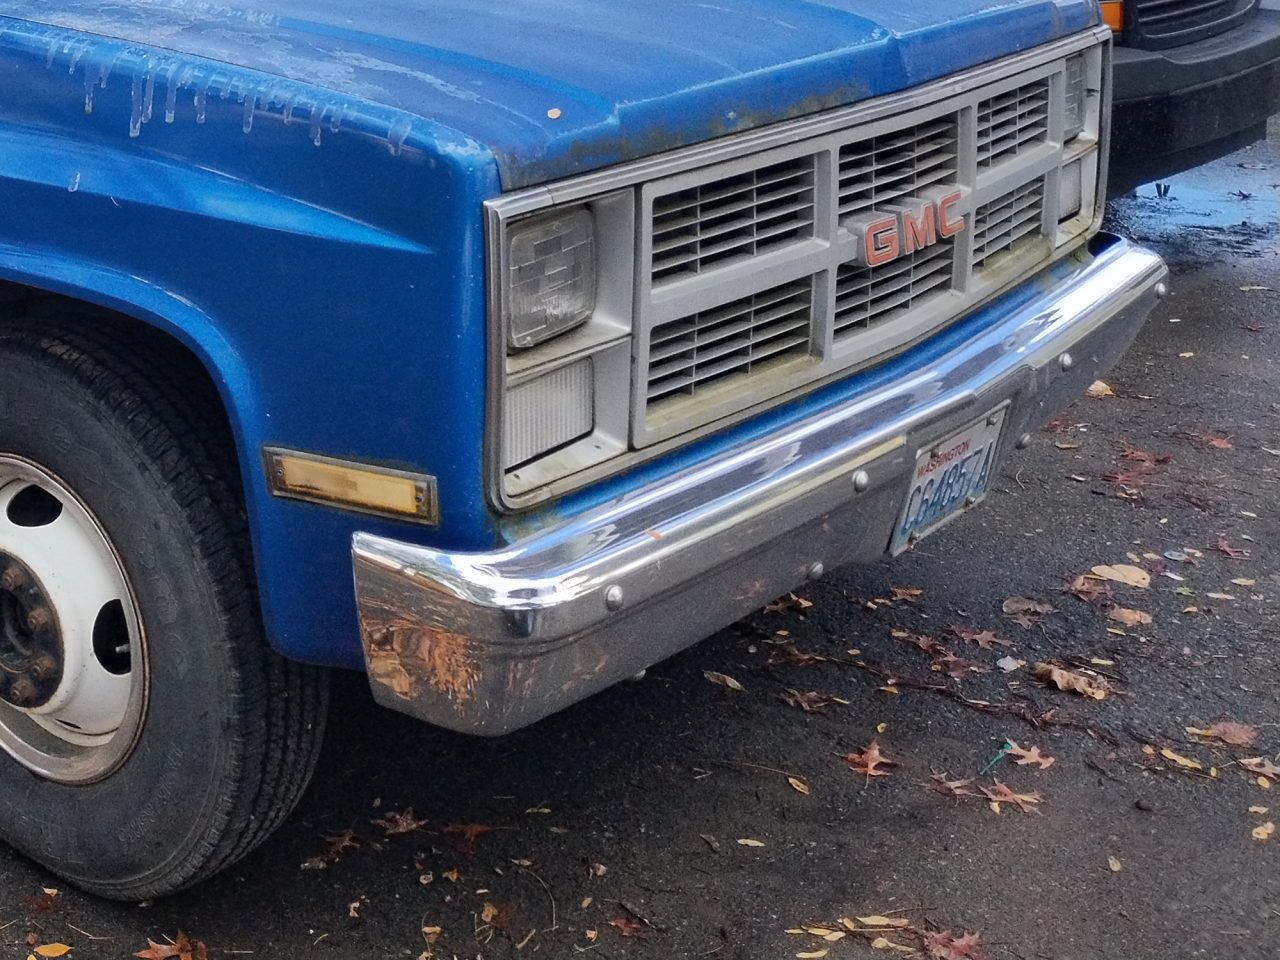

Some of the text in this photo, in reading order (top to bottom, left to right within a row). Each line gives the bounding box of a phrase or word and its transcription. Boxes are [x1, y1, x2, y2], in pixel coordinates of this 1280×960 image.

[864, 190, 966, 268] GMC
[900, 439, 994, 537] C64857A
[917, 438, 971, 479] WASHINGTON
